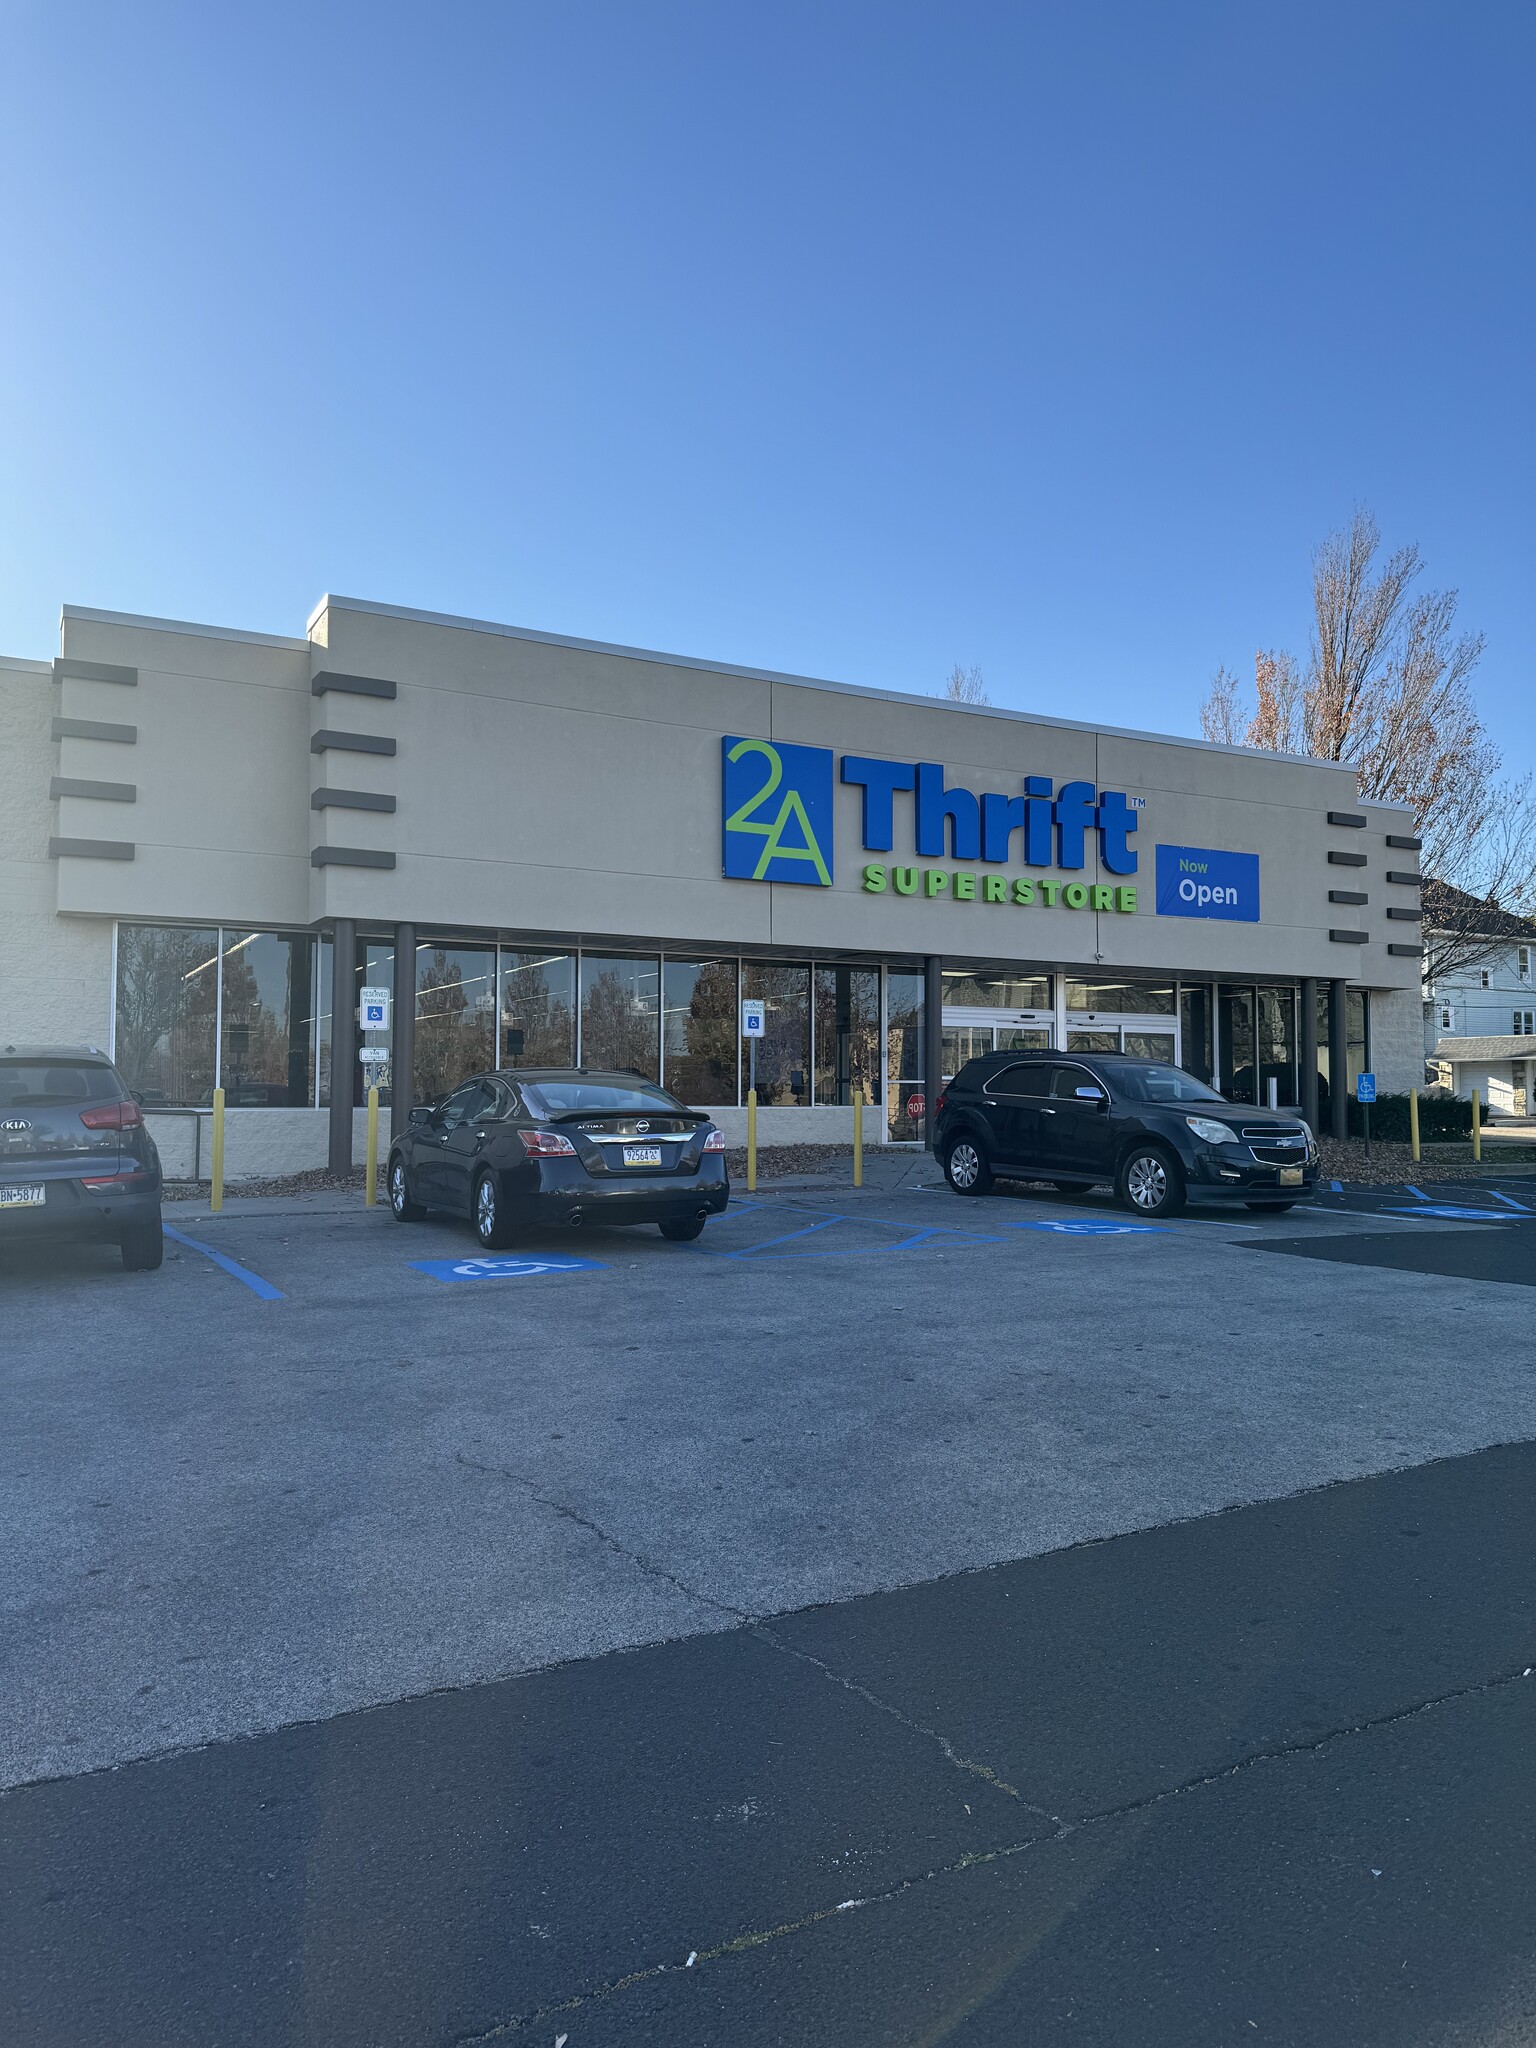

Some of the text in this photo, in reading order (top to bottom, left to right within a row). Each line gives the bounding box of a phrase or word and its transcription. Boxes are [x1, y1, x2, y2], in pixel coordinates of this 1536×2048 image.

[726, 740, 833, 886] 2A
[841, 755, 1138, 875] Thrift
[1179, 858, 1208, 874] Now
[862, 864, 1138, 912] SUPERSTORE
[1179, 878, 1238, 907] Open
[363, 990, 388, 998] RESERVED
[6, 1121, 26, 1130] KIA
